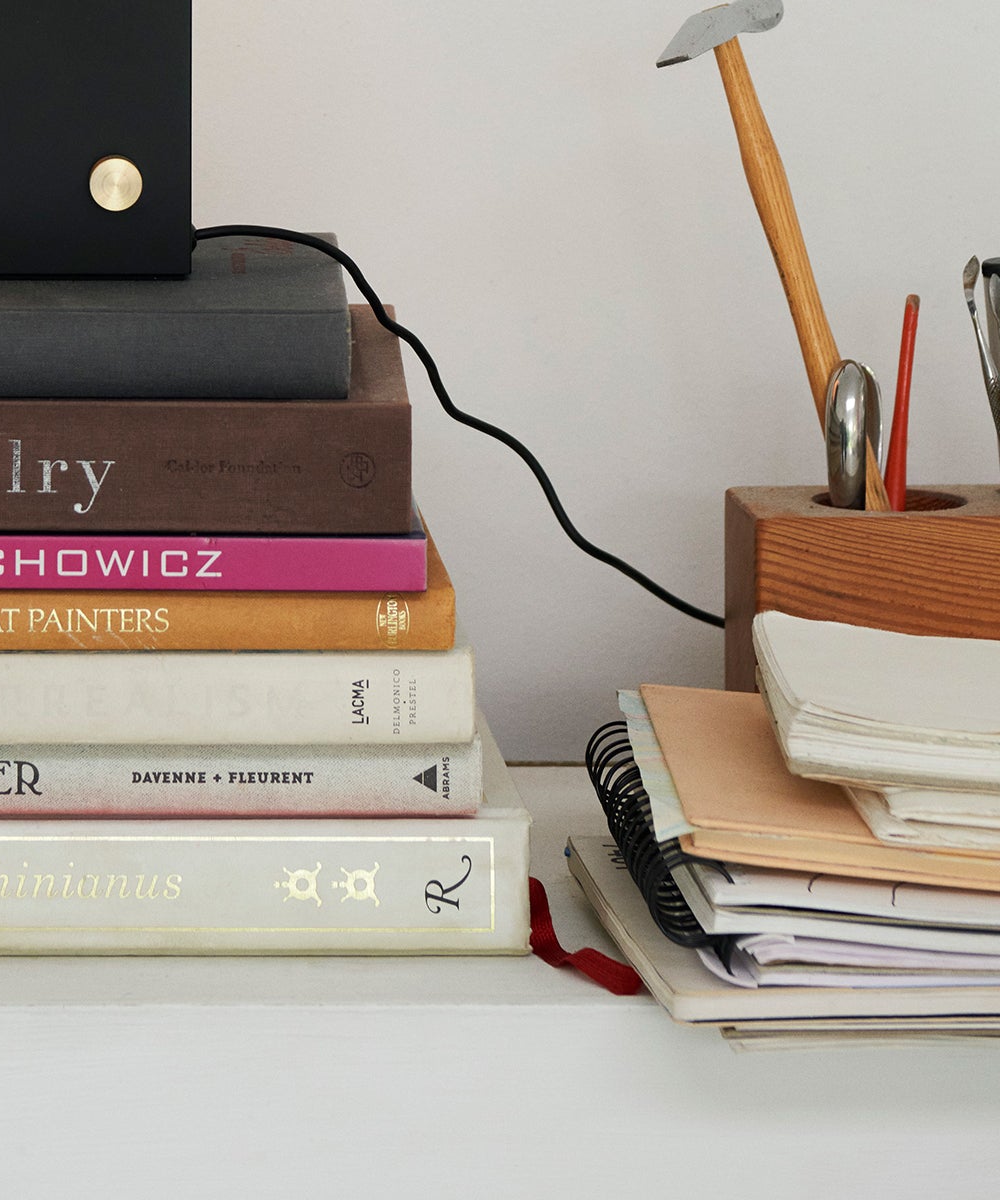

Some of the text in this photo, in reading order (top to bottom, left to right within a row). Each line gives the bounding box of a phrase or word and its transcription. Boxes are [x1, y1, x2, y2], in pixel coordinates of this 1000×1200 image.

[27, 608, 170, 633] PAINTERS
[398, 610, 407, 630] BOOKS
[352, 680, 366, 724] LACMA
[393, 669, 401, 735] DELMONICO
[408, 679, 417, 725] PRESTEL
[131, 771, 207, 785] DAVENNE
[228, 771, 314, 785] FLEURENT
[442, 756, 451, 800] ABRAMS
[424, 854, 472, 915] R
